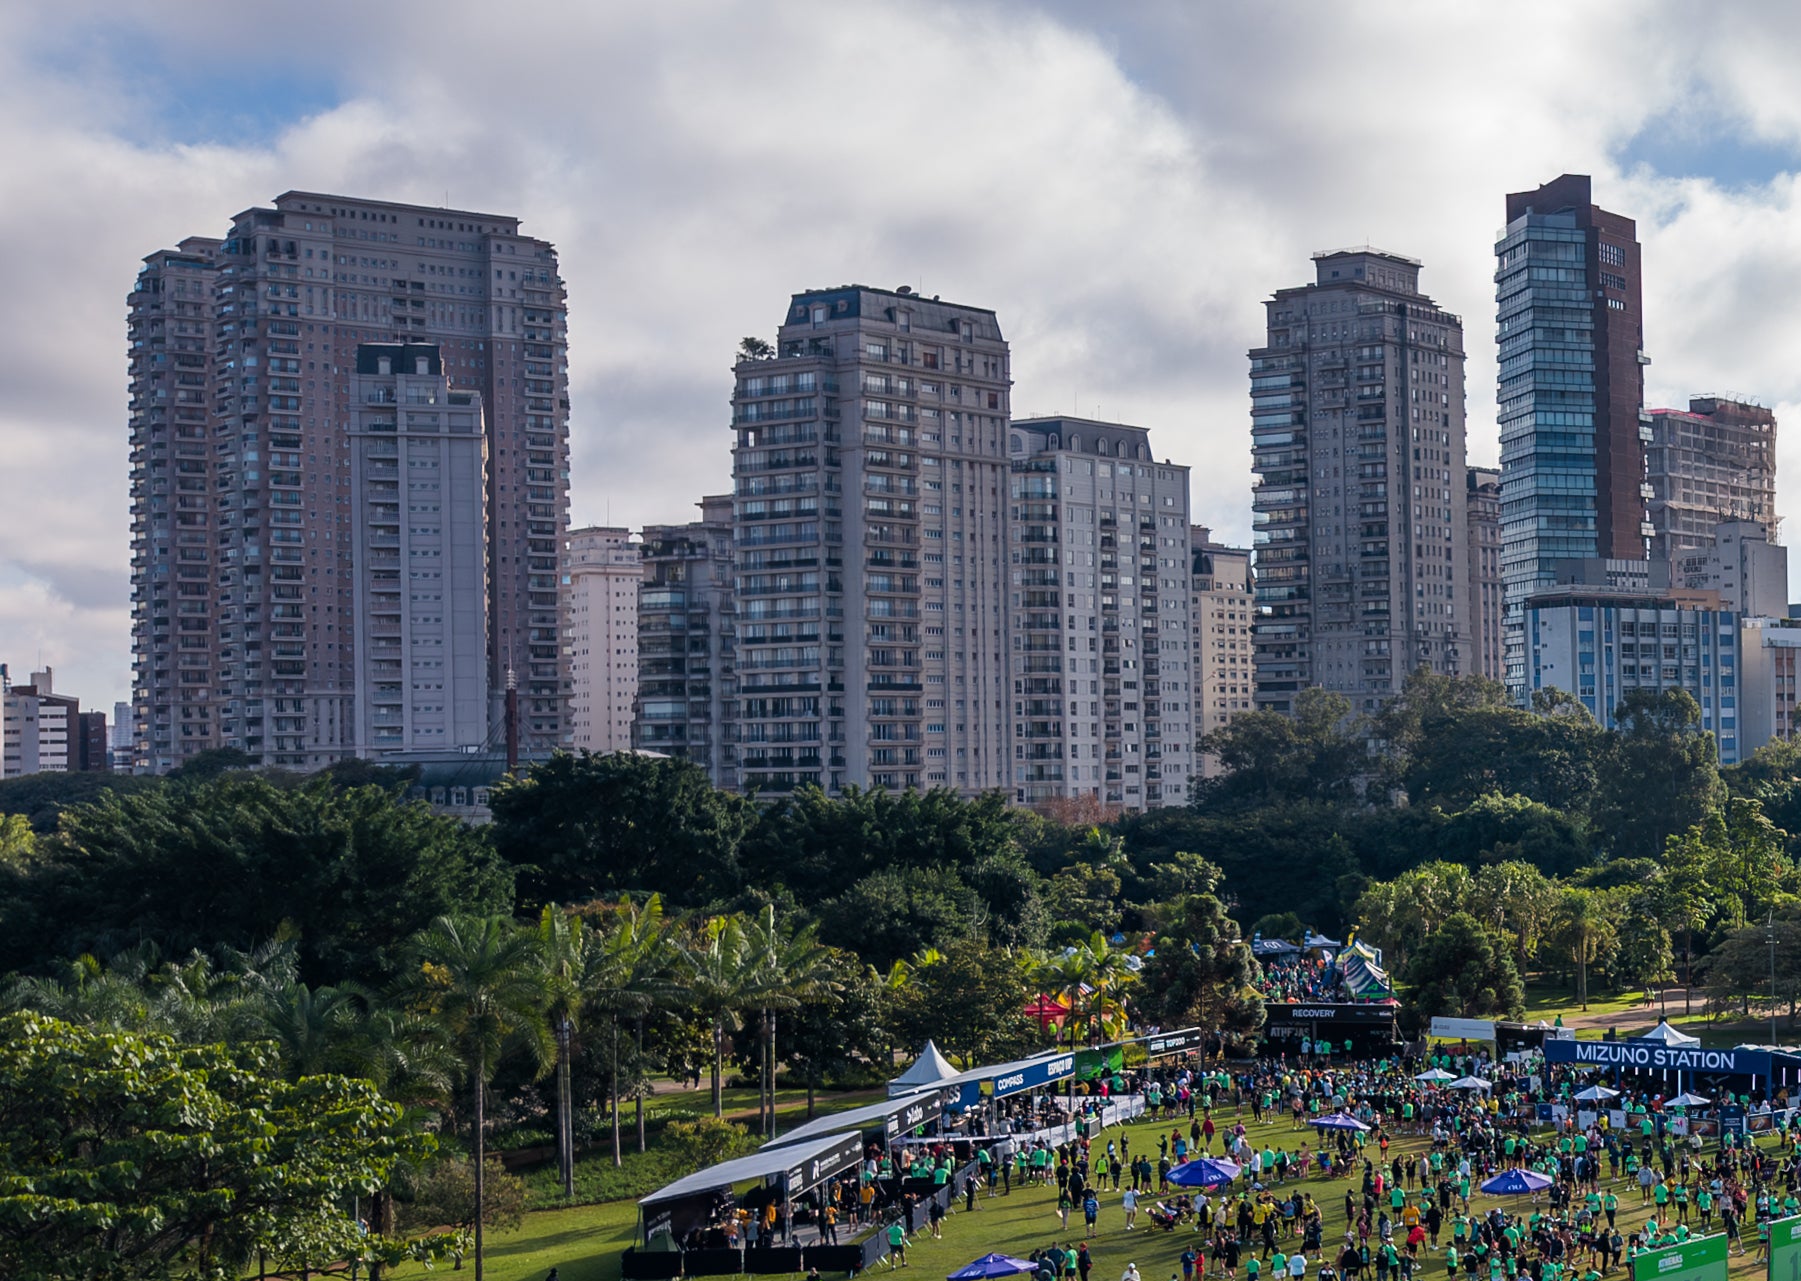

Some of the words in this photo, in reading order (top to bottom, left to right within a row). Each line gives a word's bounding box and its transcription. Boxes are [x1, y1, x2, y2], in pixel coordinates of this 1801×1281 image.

[1292, 1009, 1336, 1018] RECOVERY
[1576, 1044, 1649, 1065] MIZUNO
[1654, 1050, 1735, 1070] STATION
[997, 1073, 1024, 1091] COMPASS
